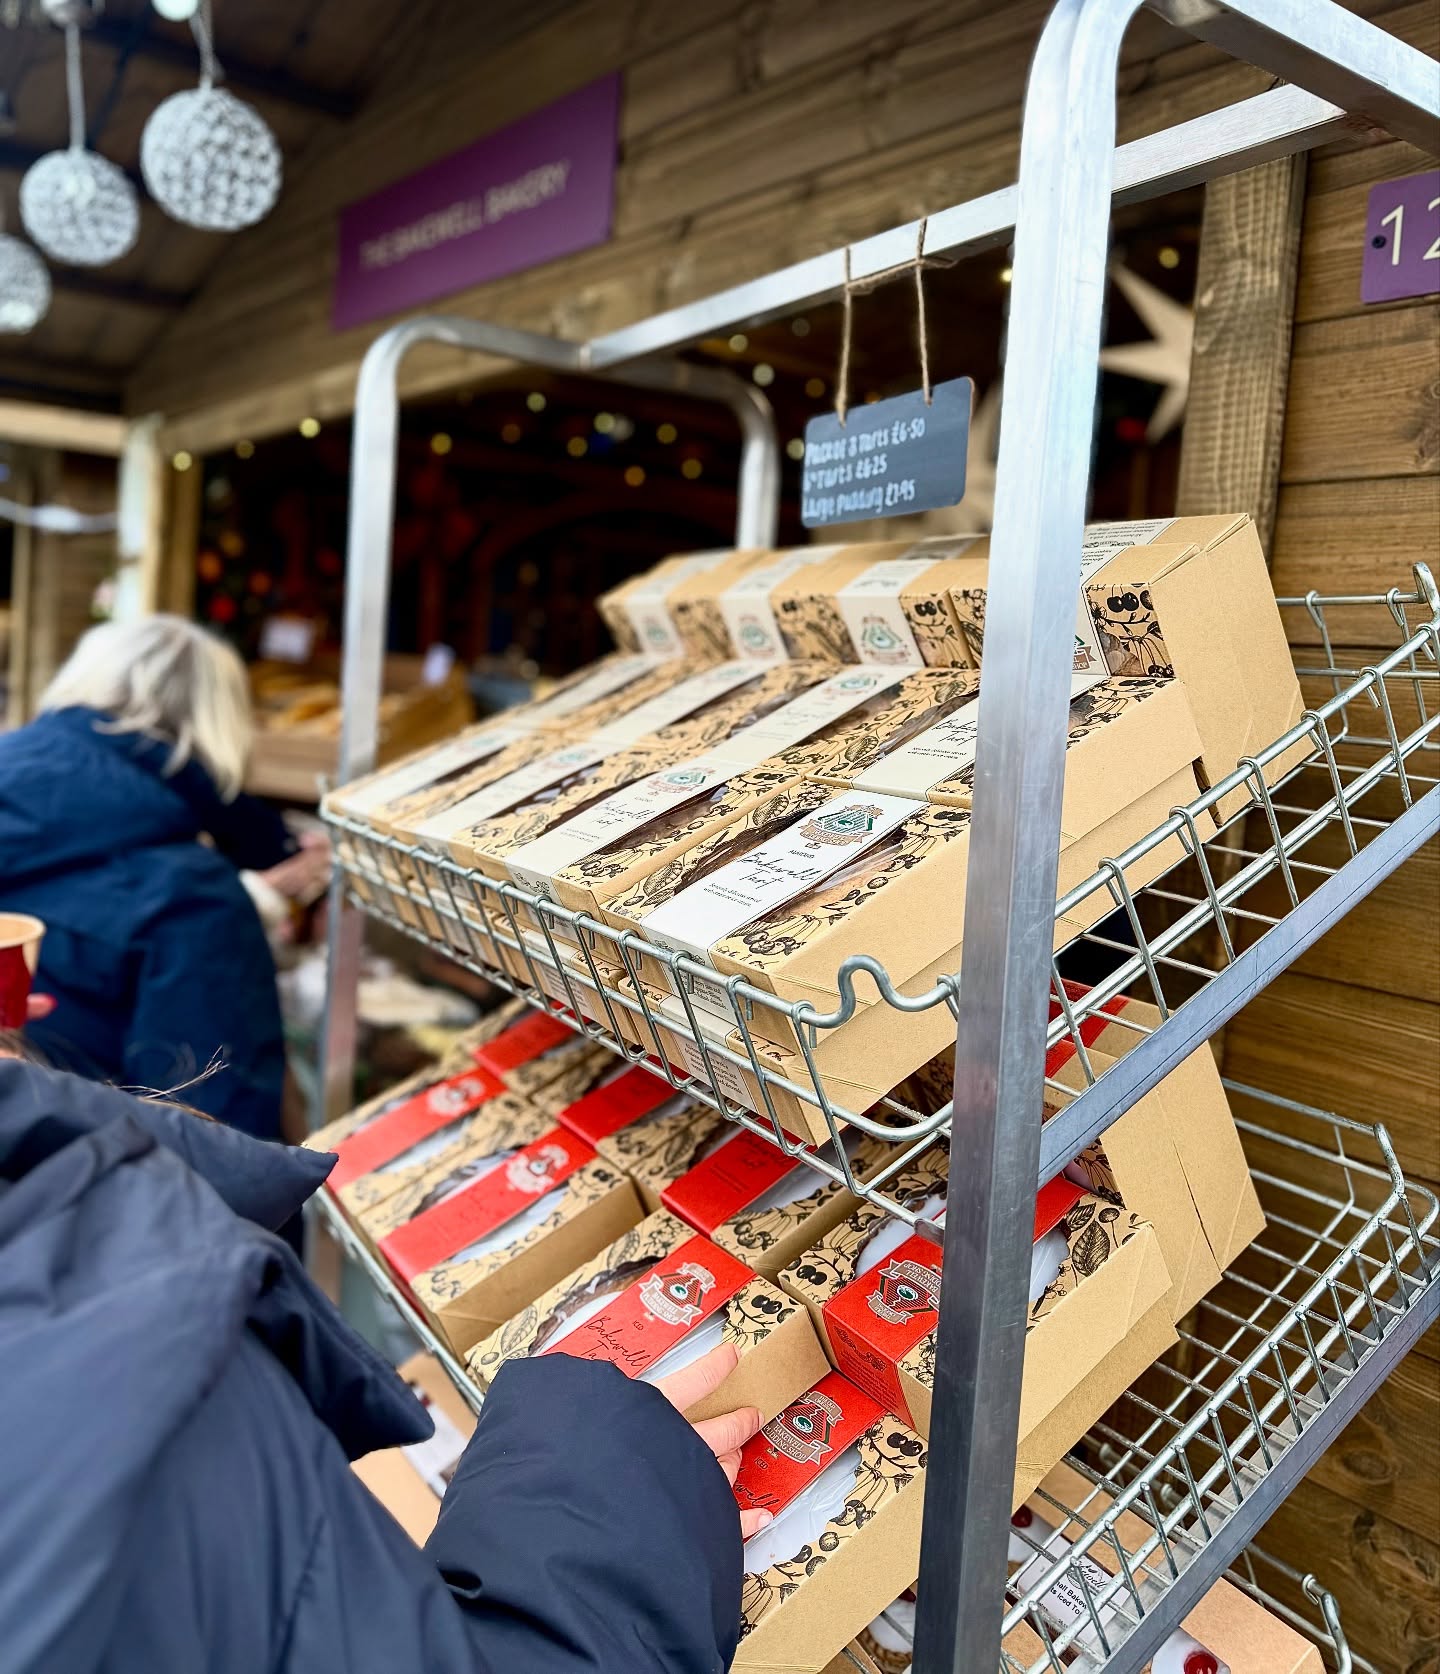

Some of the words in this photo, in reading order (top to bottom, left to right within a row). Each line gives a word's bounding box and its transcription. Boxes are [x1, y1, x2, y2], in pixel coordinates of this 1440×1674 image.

[737, 851, 823, 881] Bakewell
[739, 867, 784, 889] Tart
[905, 1269, 939, 1293] BAKEWELL
[921, 1270, 942, 1287] DDING
[580, 1340, 618, 1365] Ta
[583, 1315, 651, 1367] Bakewell
[763, 1425, 788, 1450] PUDDING
[786, 1447, 807, 1459] SHOP
[774, 1424, 804, 1451] BAKEWELL
[735, 1484, 780, 1508] well
[1057, 1592, 1072, 1607] Iced
[1071, 1604, 1083, 1615] To
[1066, 1589, 1087, 1610] Bakew
